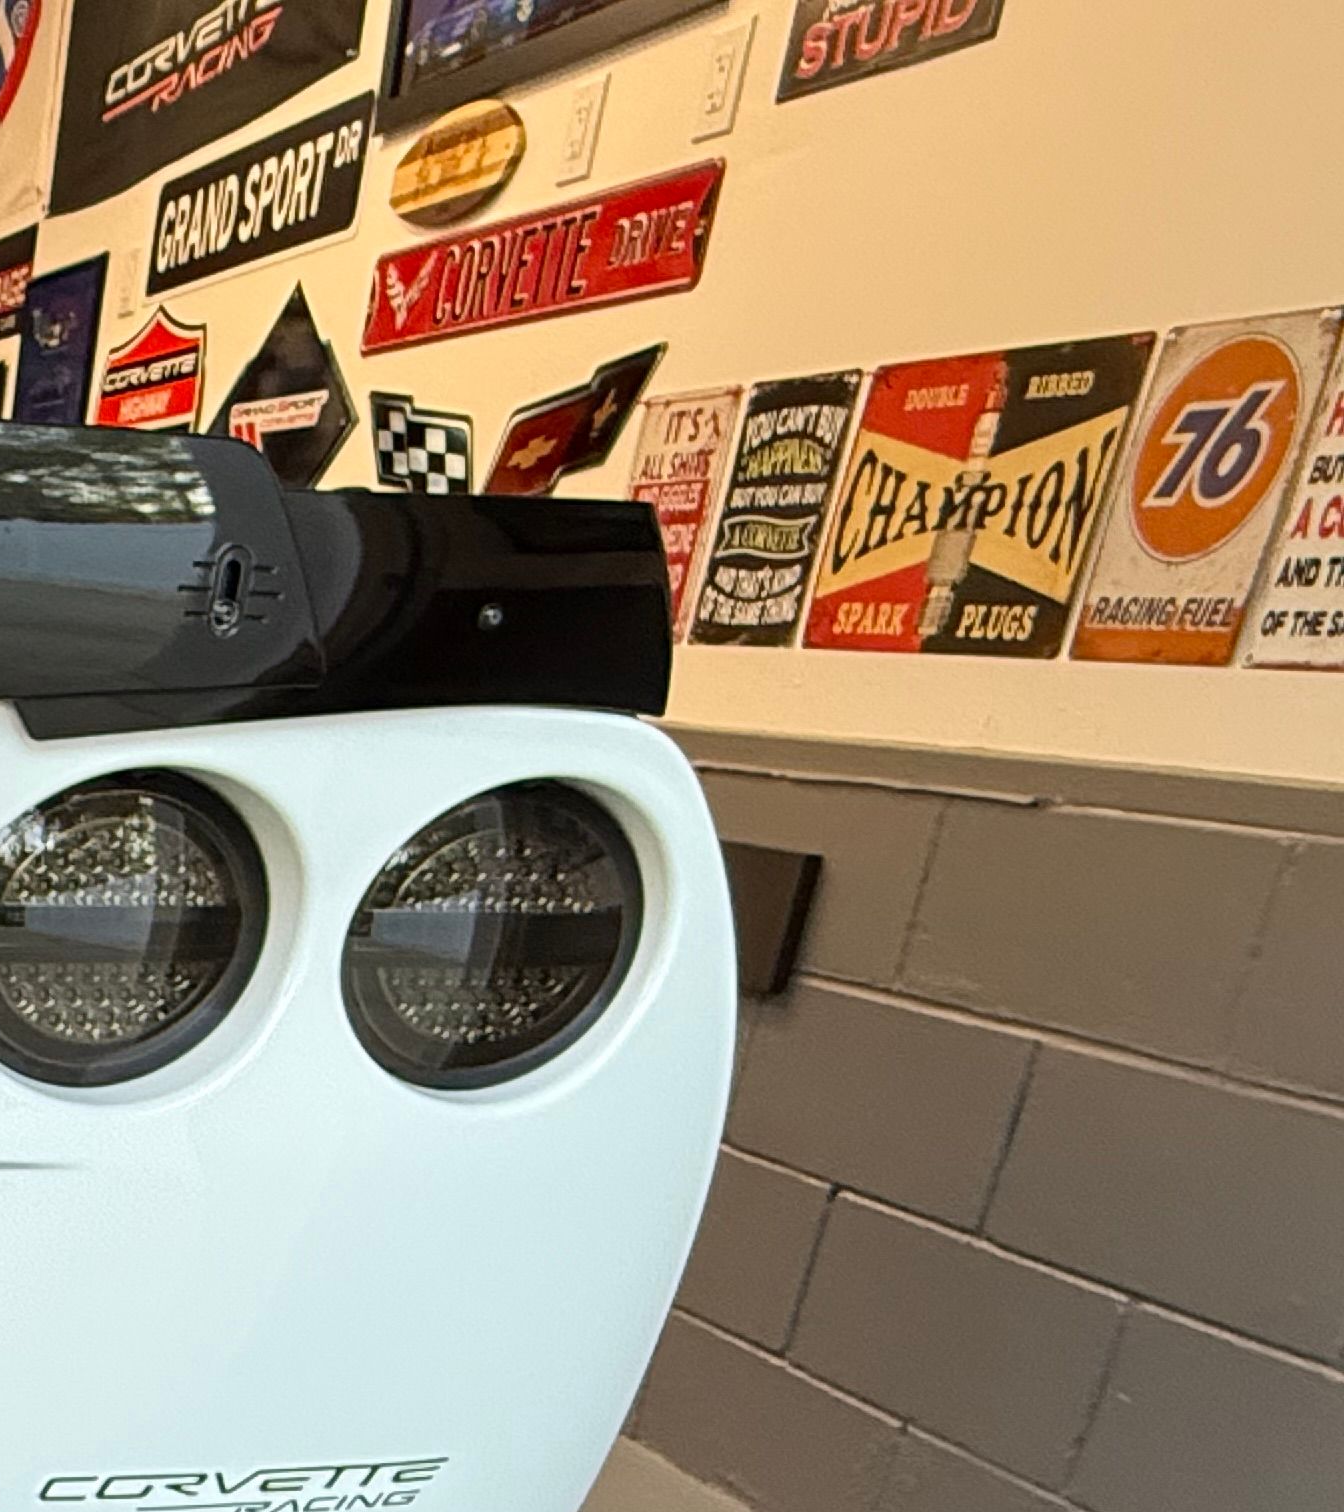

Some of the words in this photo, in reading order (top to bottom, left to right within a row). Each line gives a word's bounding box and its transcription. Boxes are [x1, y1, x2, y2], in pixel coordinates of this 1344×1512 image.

[794, 0, 979, 79] STUPID
[102, 5, 284, 122] RACING
[156, 173, 239, 274] GRAND
[238, 132, 334, 244] SPORT
[332, 120, 363, 168] DR
[433, 204, 603, 325] CORVETTE
[609, 201, 695, 269] DRIVE
[103, 352, 197, 392] CORVETTE
[904, 384, 970, 412] DOUBLE
[1024, 370, 1096, 401] RIBBED
[232, 401, 277, 419] GRAND
[277, 393, 325, 413] SPORT
[1142, 379, 1288, 508] 76
[832, 427, 1119, 576] CHAMPION
[1290, 497, 1314, 540] A
[1275, 556, 1322, 588] AND
[832, 602, 912, 636] SPARK
[956, 604, 1040, 642] PLUGS
[1089, 596, 1176, 628] RACING
[1177, 597, 1235, 628] FUEL
[1261, 610, 1289, 637] OF
[1290, 610, 1328, 636] THE
[38, 1456, 450, 1502] CORVETTE
